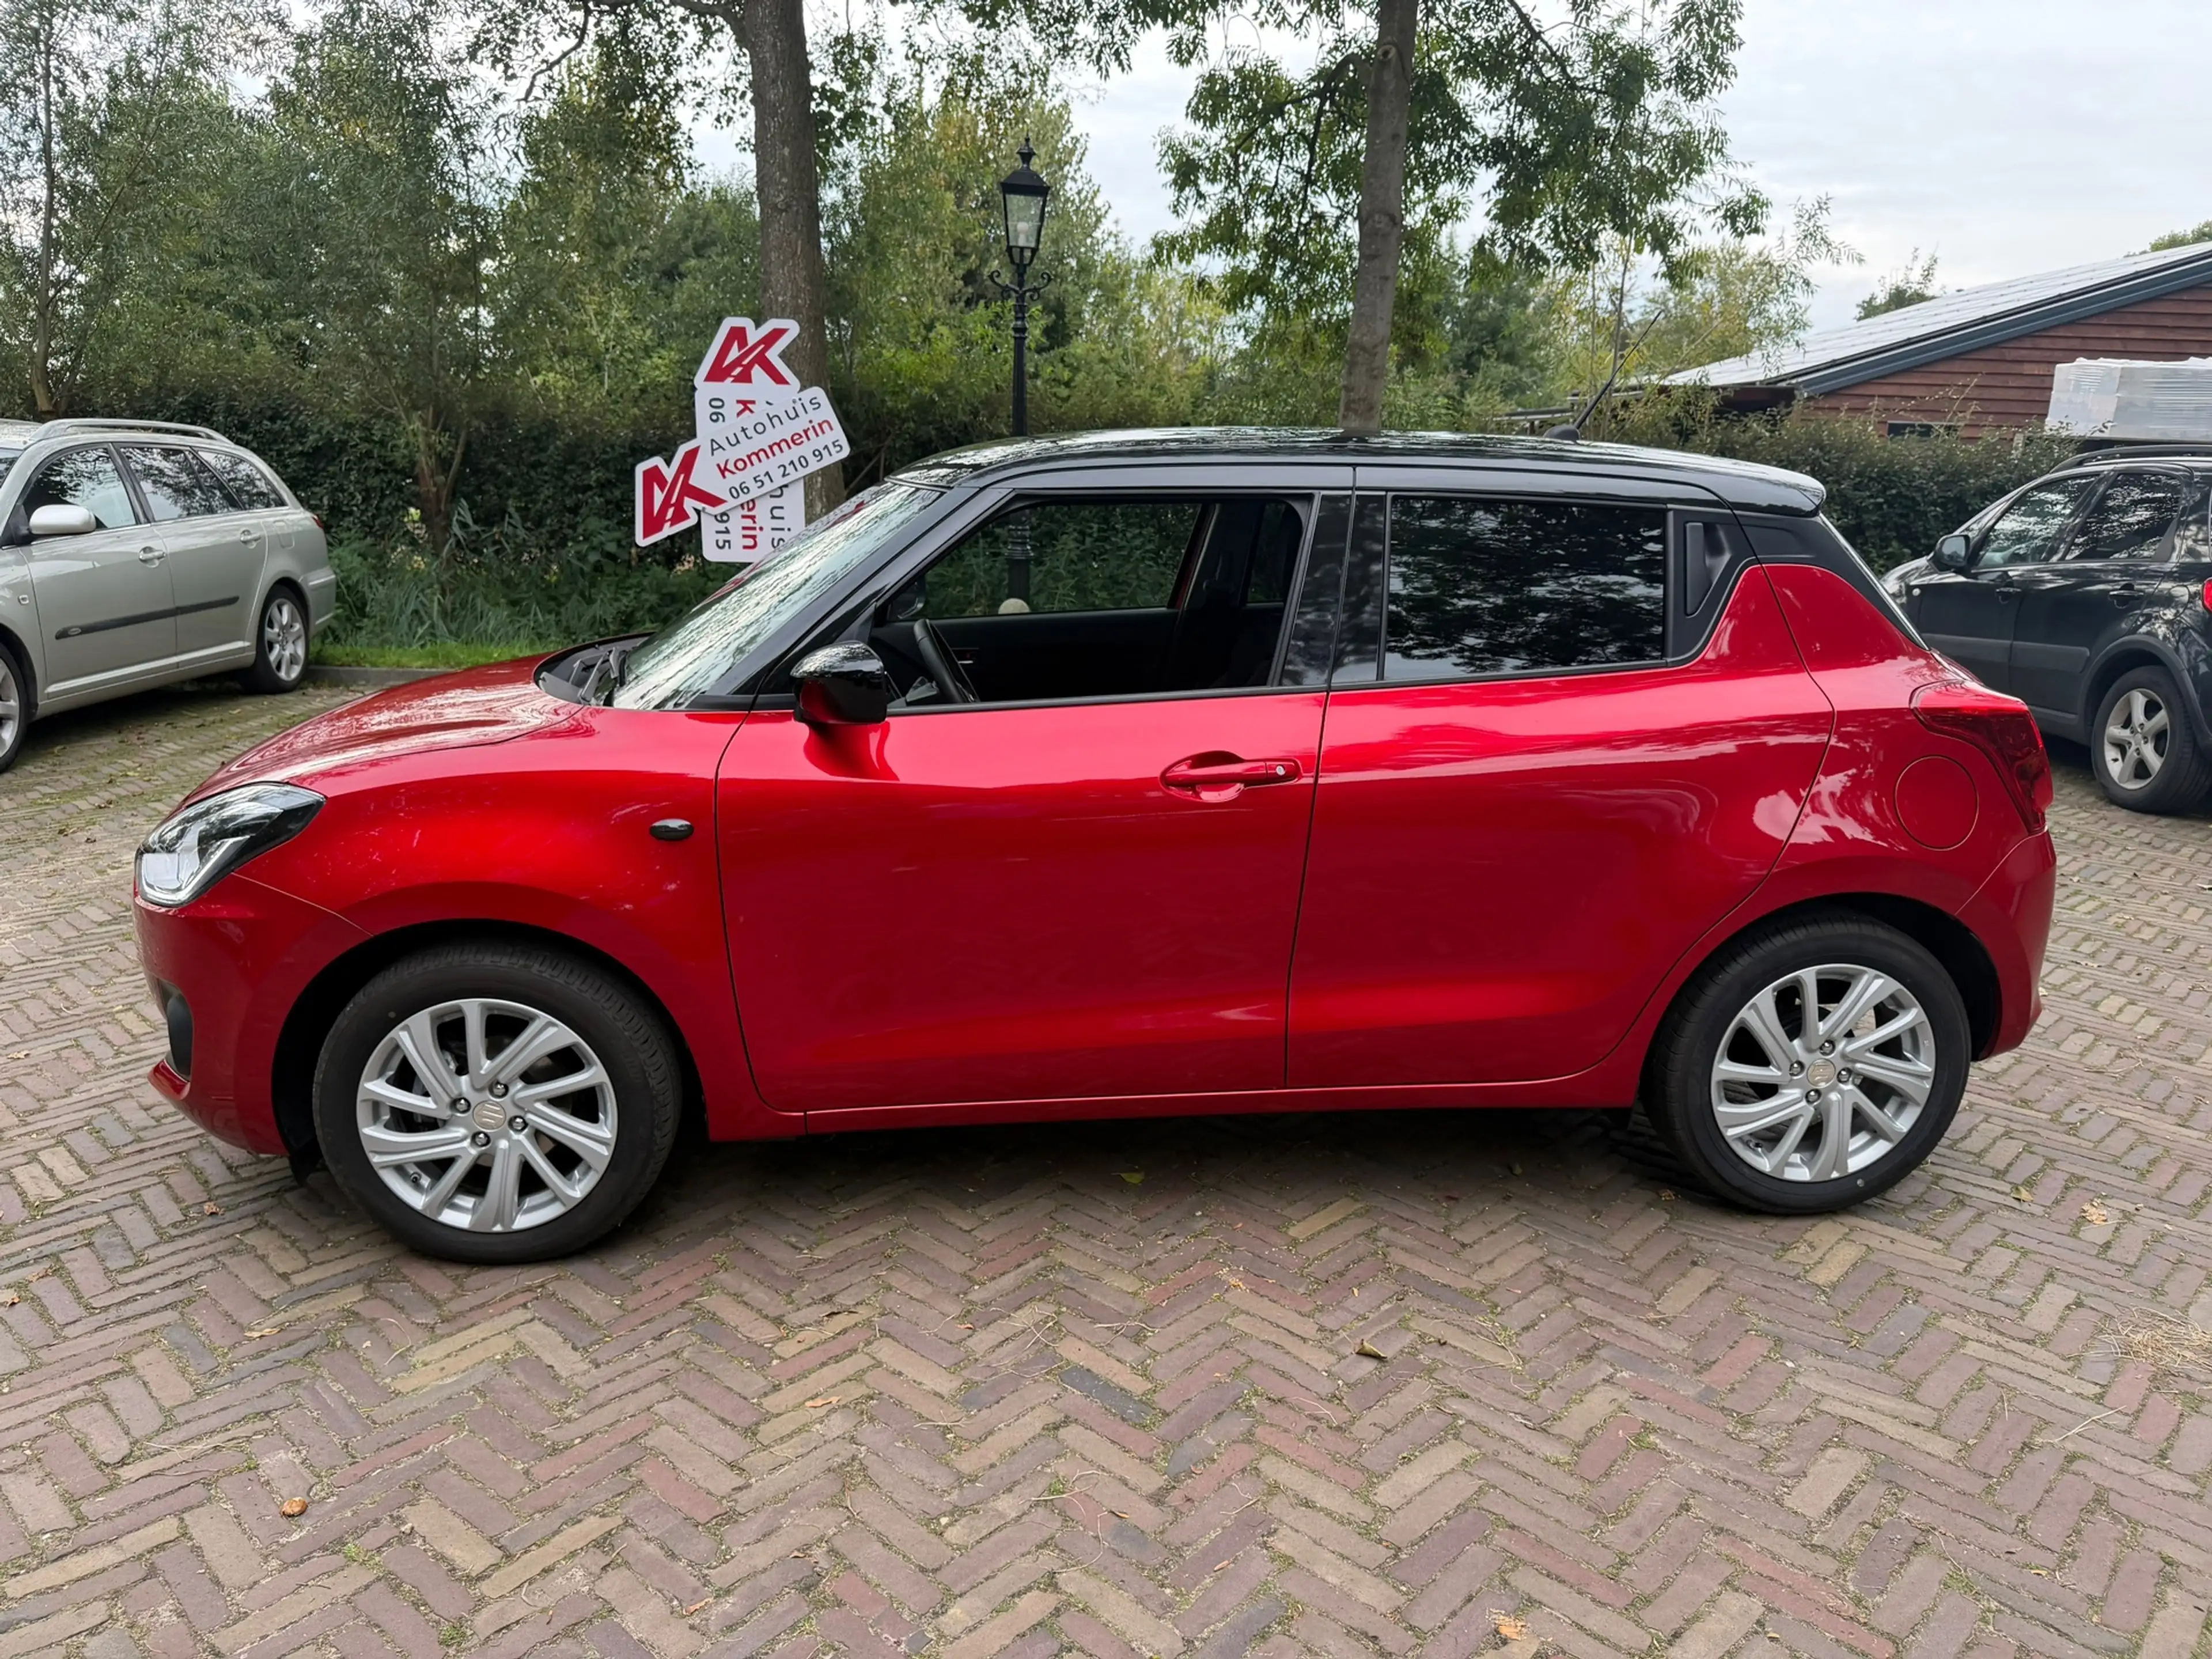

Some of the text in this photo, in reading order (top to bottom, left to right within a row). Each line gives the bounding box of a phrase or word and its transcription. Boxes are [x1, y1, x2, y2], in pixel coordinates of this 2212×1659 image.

[709, 396, 821, 457] Autohuis
[716, 419, 834, 479] Kommerin
[709, 397, 731, 550] 06 915
[729, 439, 843, 499] 06 51 210 915
